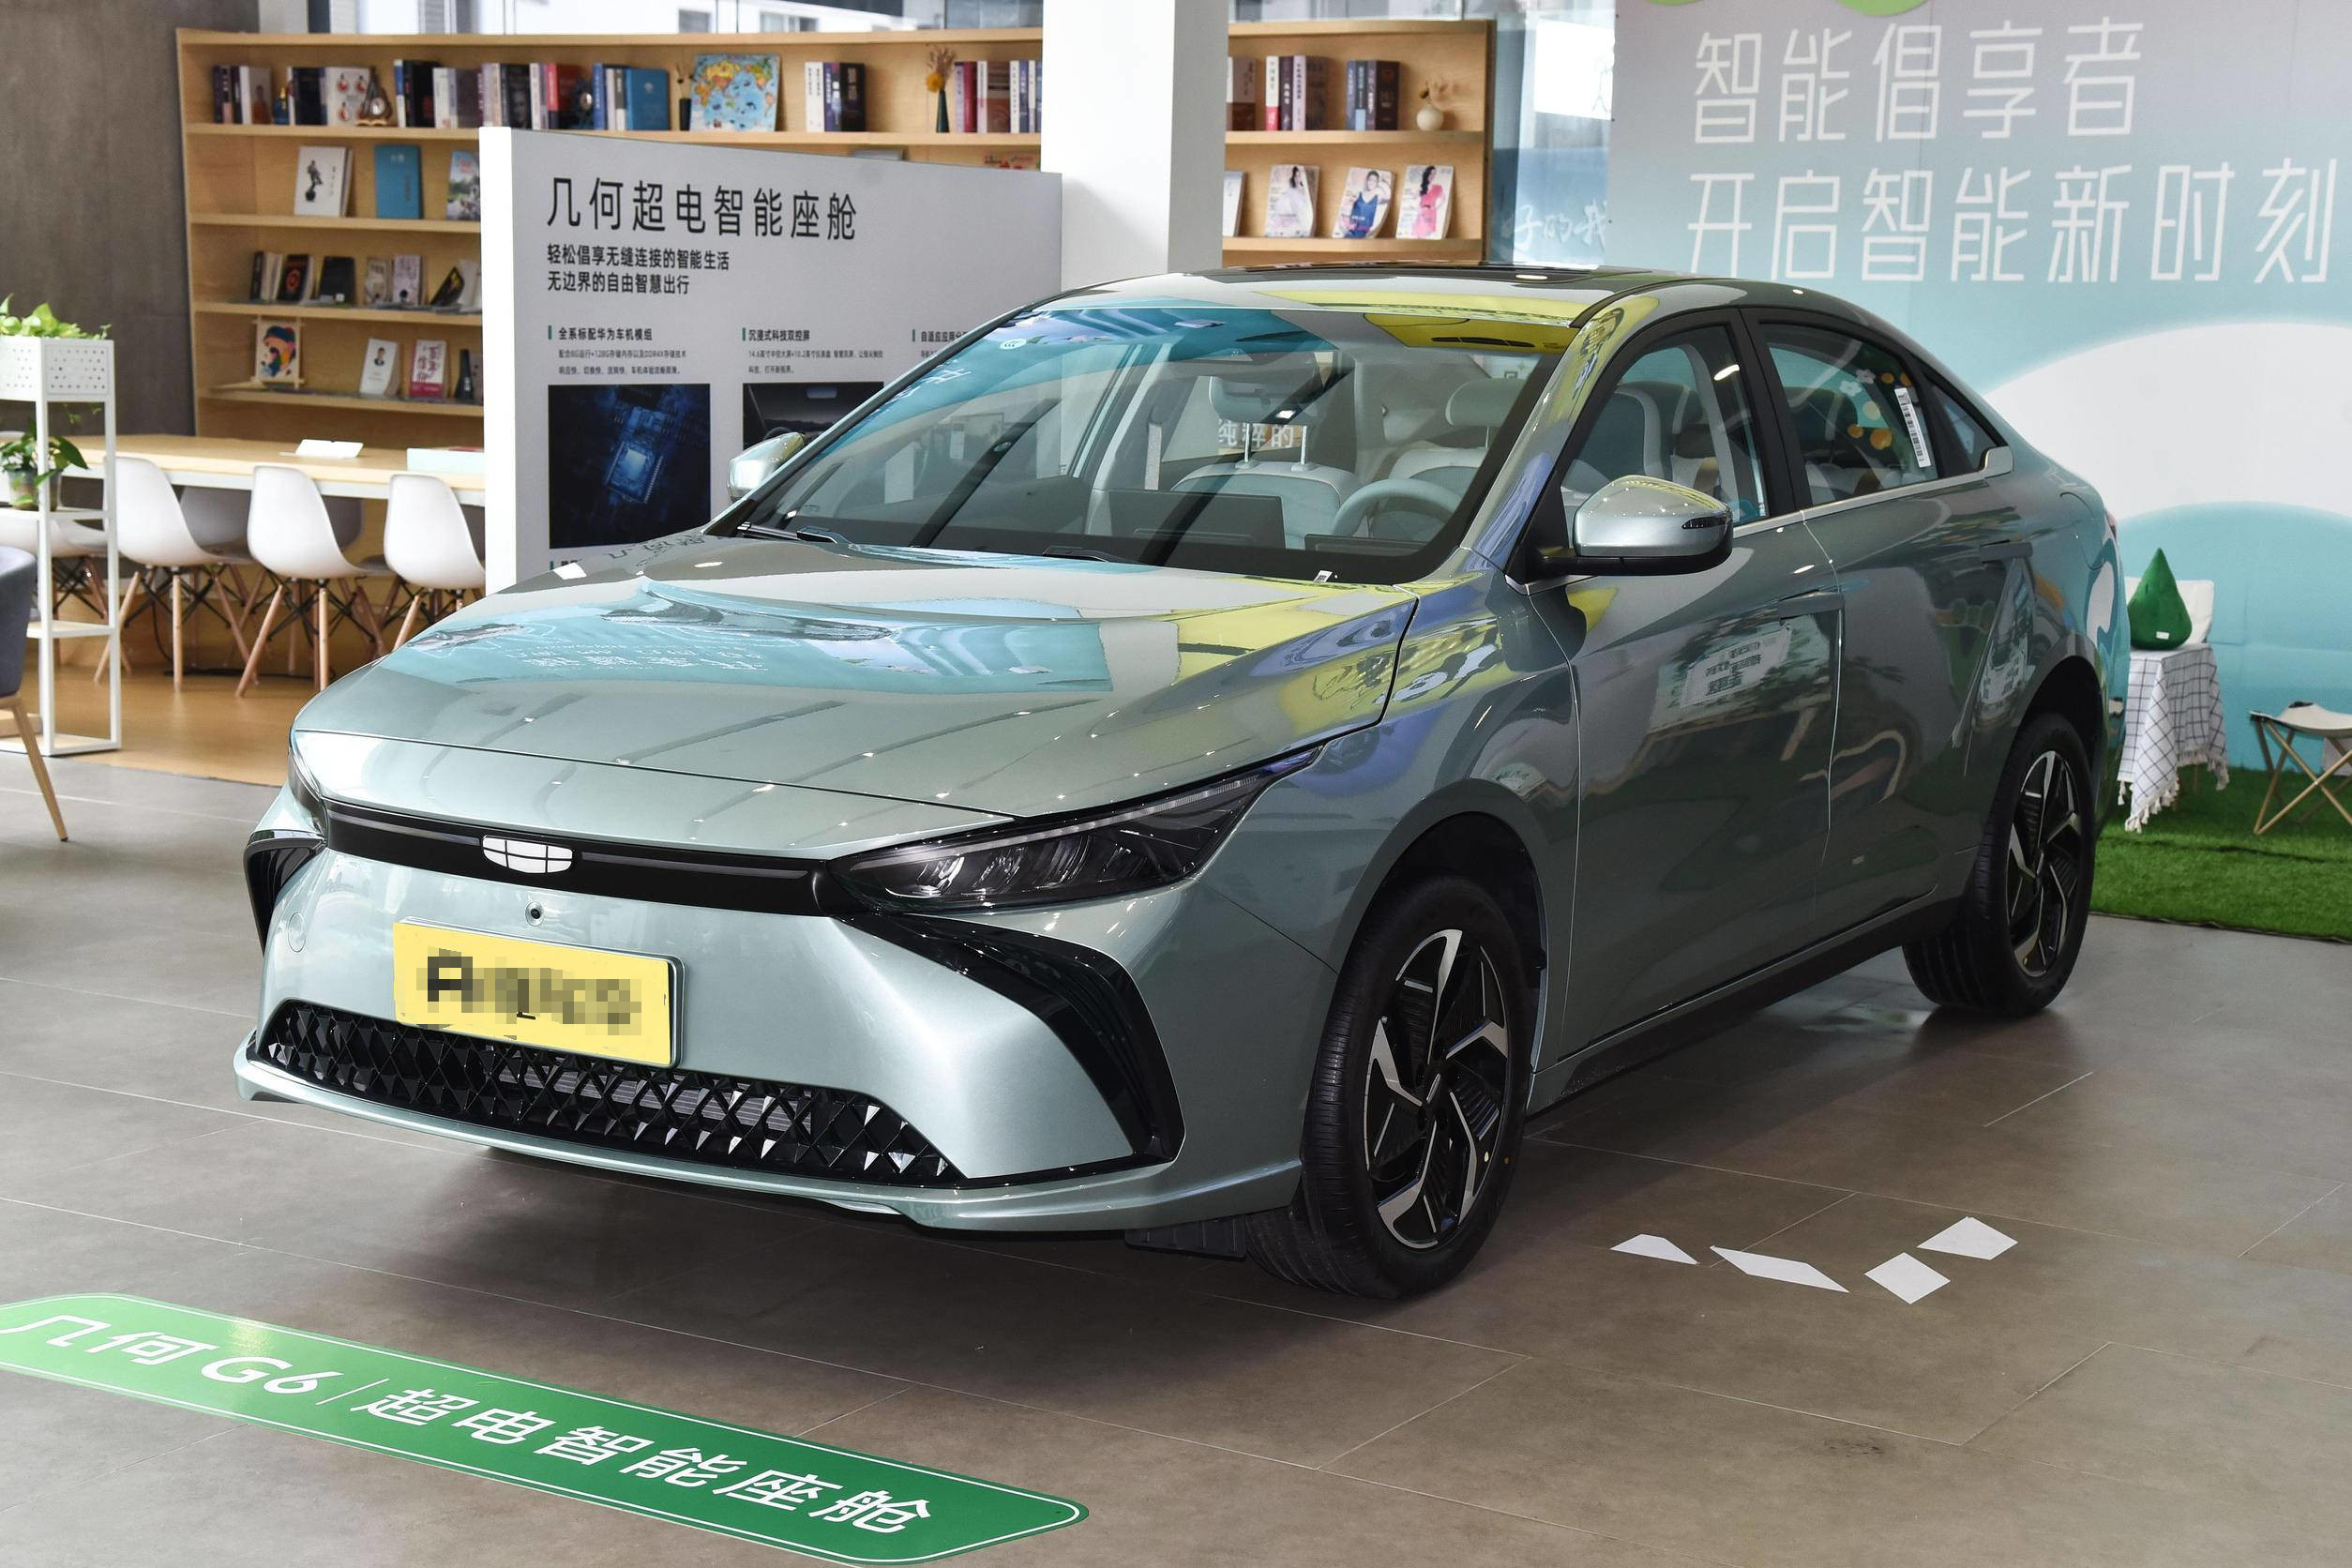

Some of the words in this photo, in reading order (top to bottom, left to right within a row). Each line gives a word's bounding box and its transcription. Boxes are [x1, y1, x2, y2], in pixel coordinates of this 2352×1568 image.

[1694, 16, 2145, 144] 智能倡享者
[547, 176, 857, 241] 几何超电智能座舱
[1686, 158, 2338, 284] 开启智能新时刻
[547, 244, 730, 271] 轻松倡享无缝连接的智能生活
[547, 270, 690, 295] 无边界的自由智慧出行
[558, 326, 653, 341] 全系标配华为车机模组
[349, 1387, 932, 1534] 超电智能座舱
